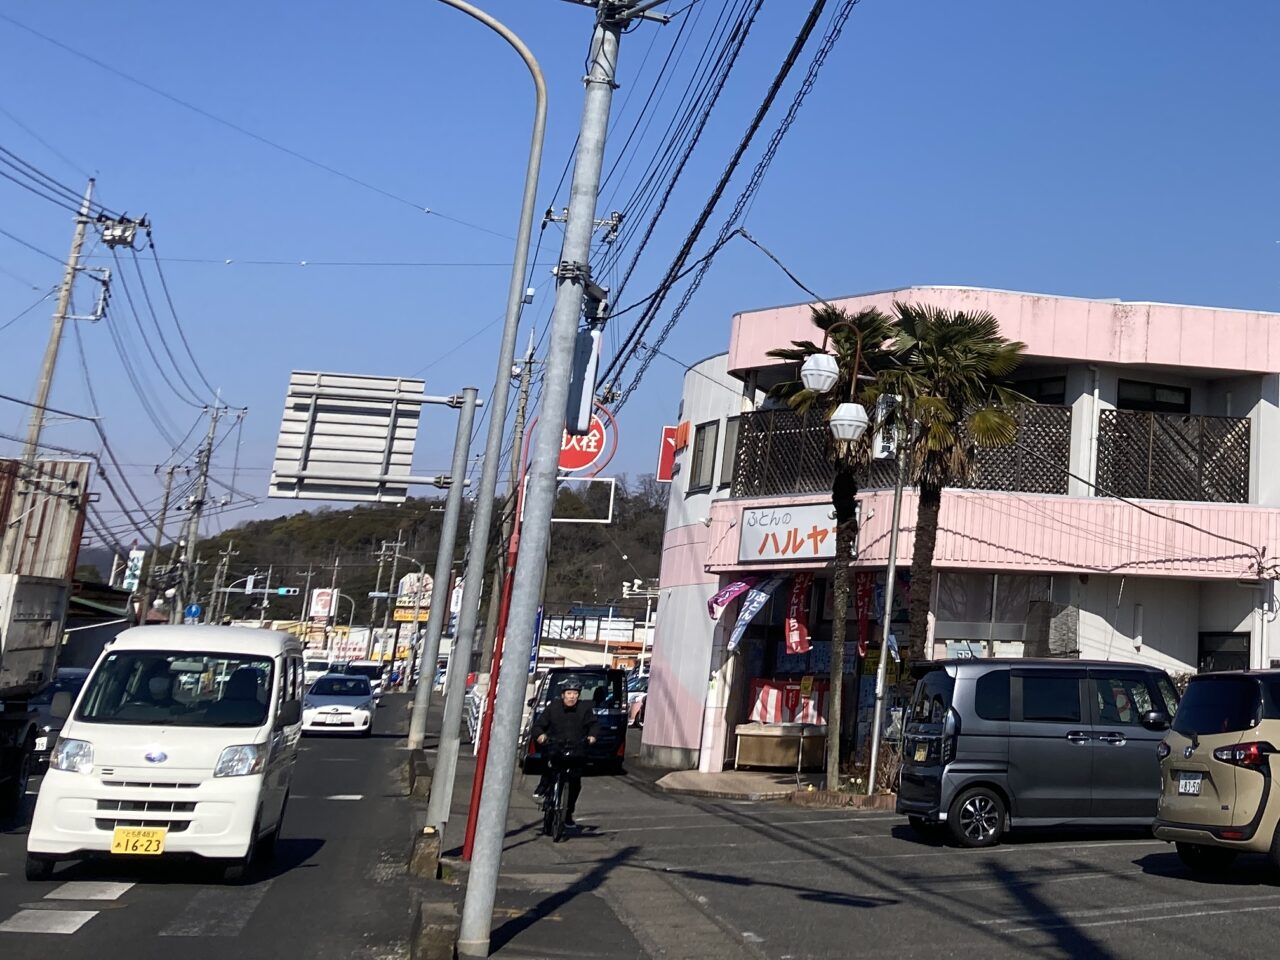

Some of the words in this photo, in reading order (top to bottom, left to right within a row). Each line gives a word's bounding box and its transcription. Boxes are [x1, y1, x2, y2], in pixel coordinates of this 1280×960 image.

[747, 510, 792, 527] ふとんの
[758, 525, 838, 556] ハルヤ
[125, 839, 161, 852] 16-23
